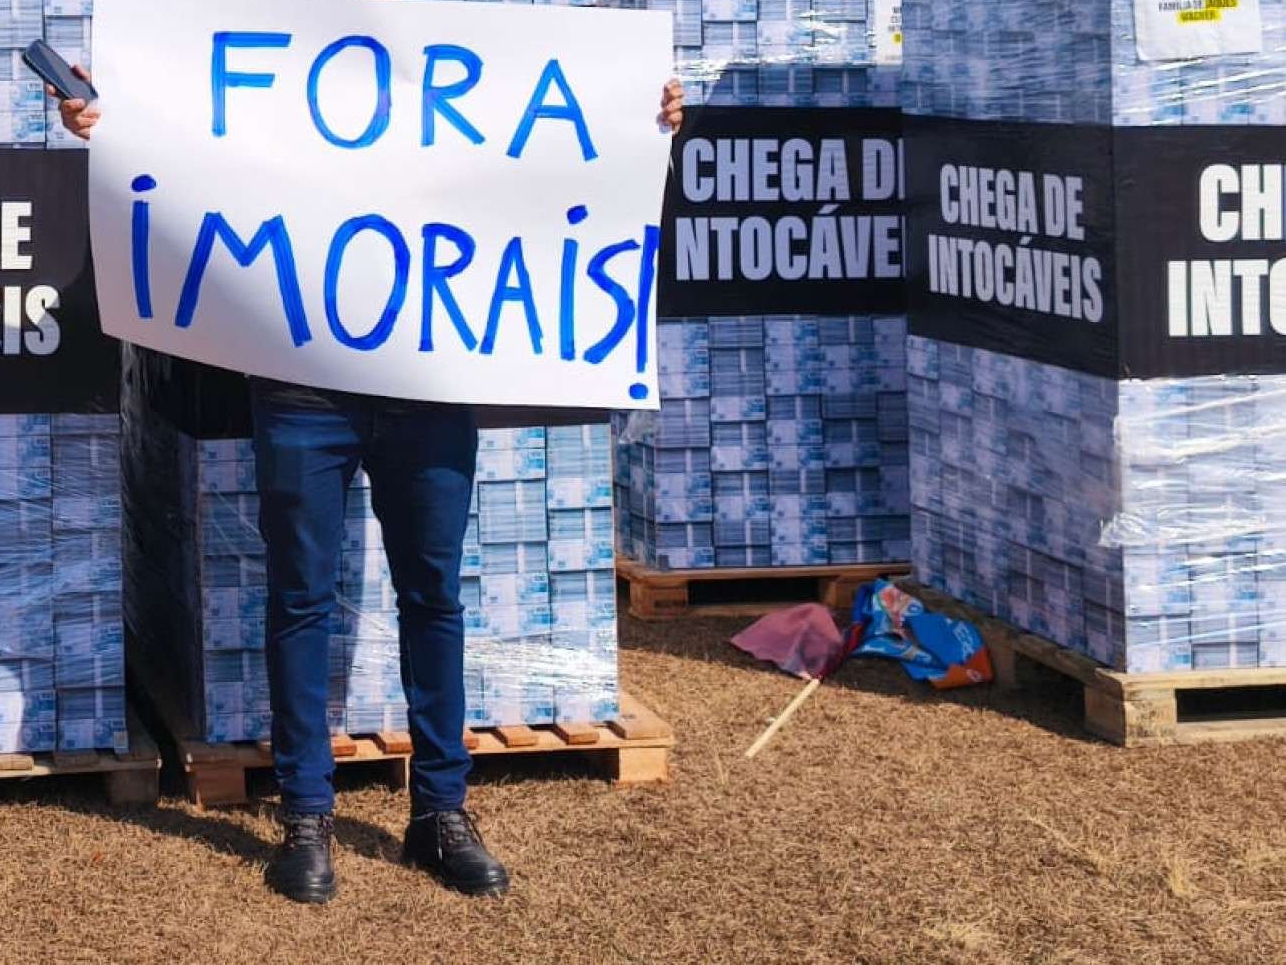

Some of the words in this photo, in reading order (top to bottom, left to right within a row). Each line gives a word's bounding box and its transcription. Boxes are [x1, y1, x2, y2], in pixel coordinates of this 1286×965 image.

[211, 31, 598, 161] FORA
[682, 138, 850, 202] CHEGA
[940, 163, 1038, 234] CHEGA
[1042, 173, 1085, 241] DE
[1199, 164, 1286, 242] CH
[675, 204, 906, 280] NTOCÁVE
[928, 234, 1104, 322] INTOCÁVEIS
